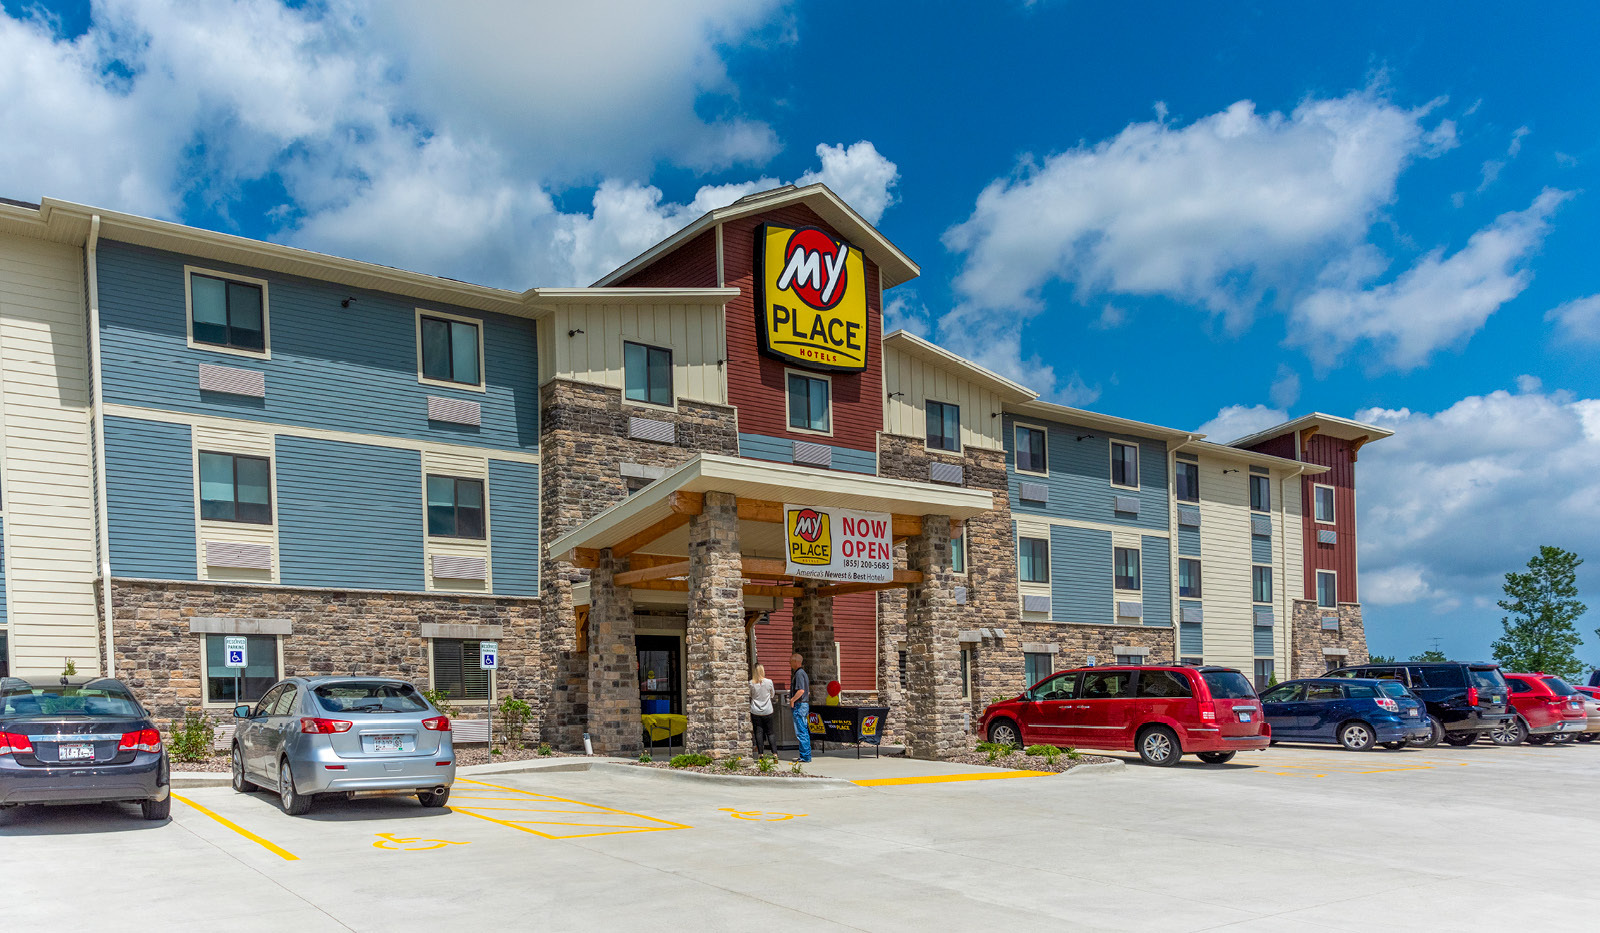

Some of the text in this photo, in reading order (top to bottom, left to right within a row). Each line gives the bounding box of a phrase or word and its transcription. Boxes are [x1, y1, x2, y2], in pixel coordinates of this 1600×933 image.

[772, 303, 861, 351] PLACE
[800, 348, 837, 362] HOTELS
[842, 517, 887, 539] NOW
[792, 543, 829, 557] PLACE
[842, 540, 890, 560] OPEN
[843, 559, 890, 570] (855) 200-5685
[795, 569, 824, 577] America's
[824, 570, 847, 579] Newest
[867, 573, 885, 581] Hotels
